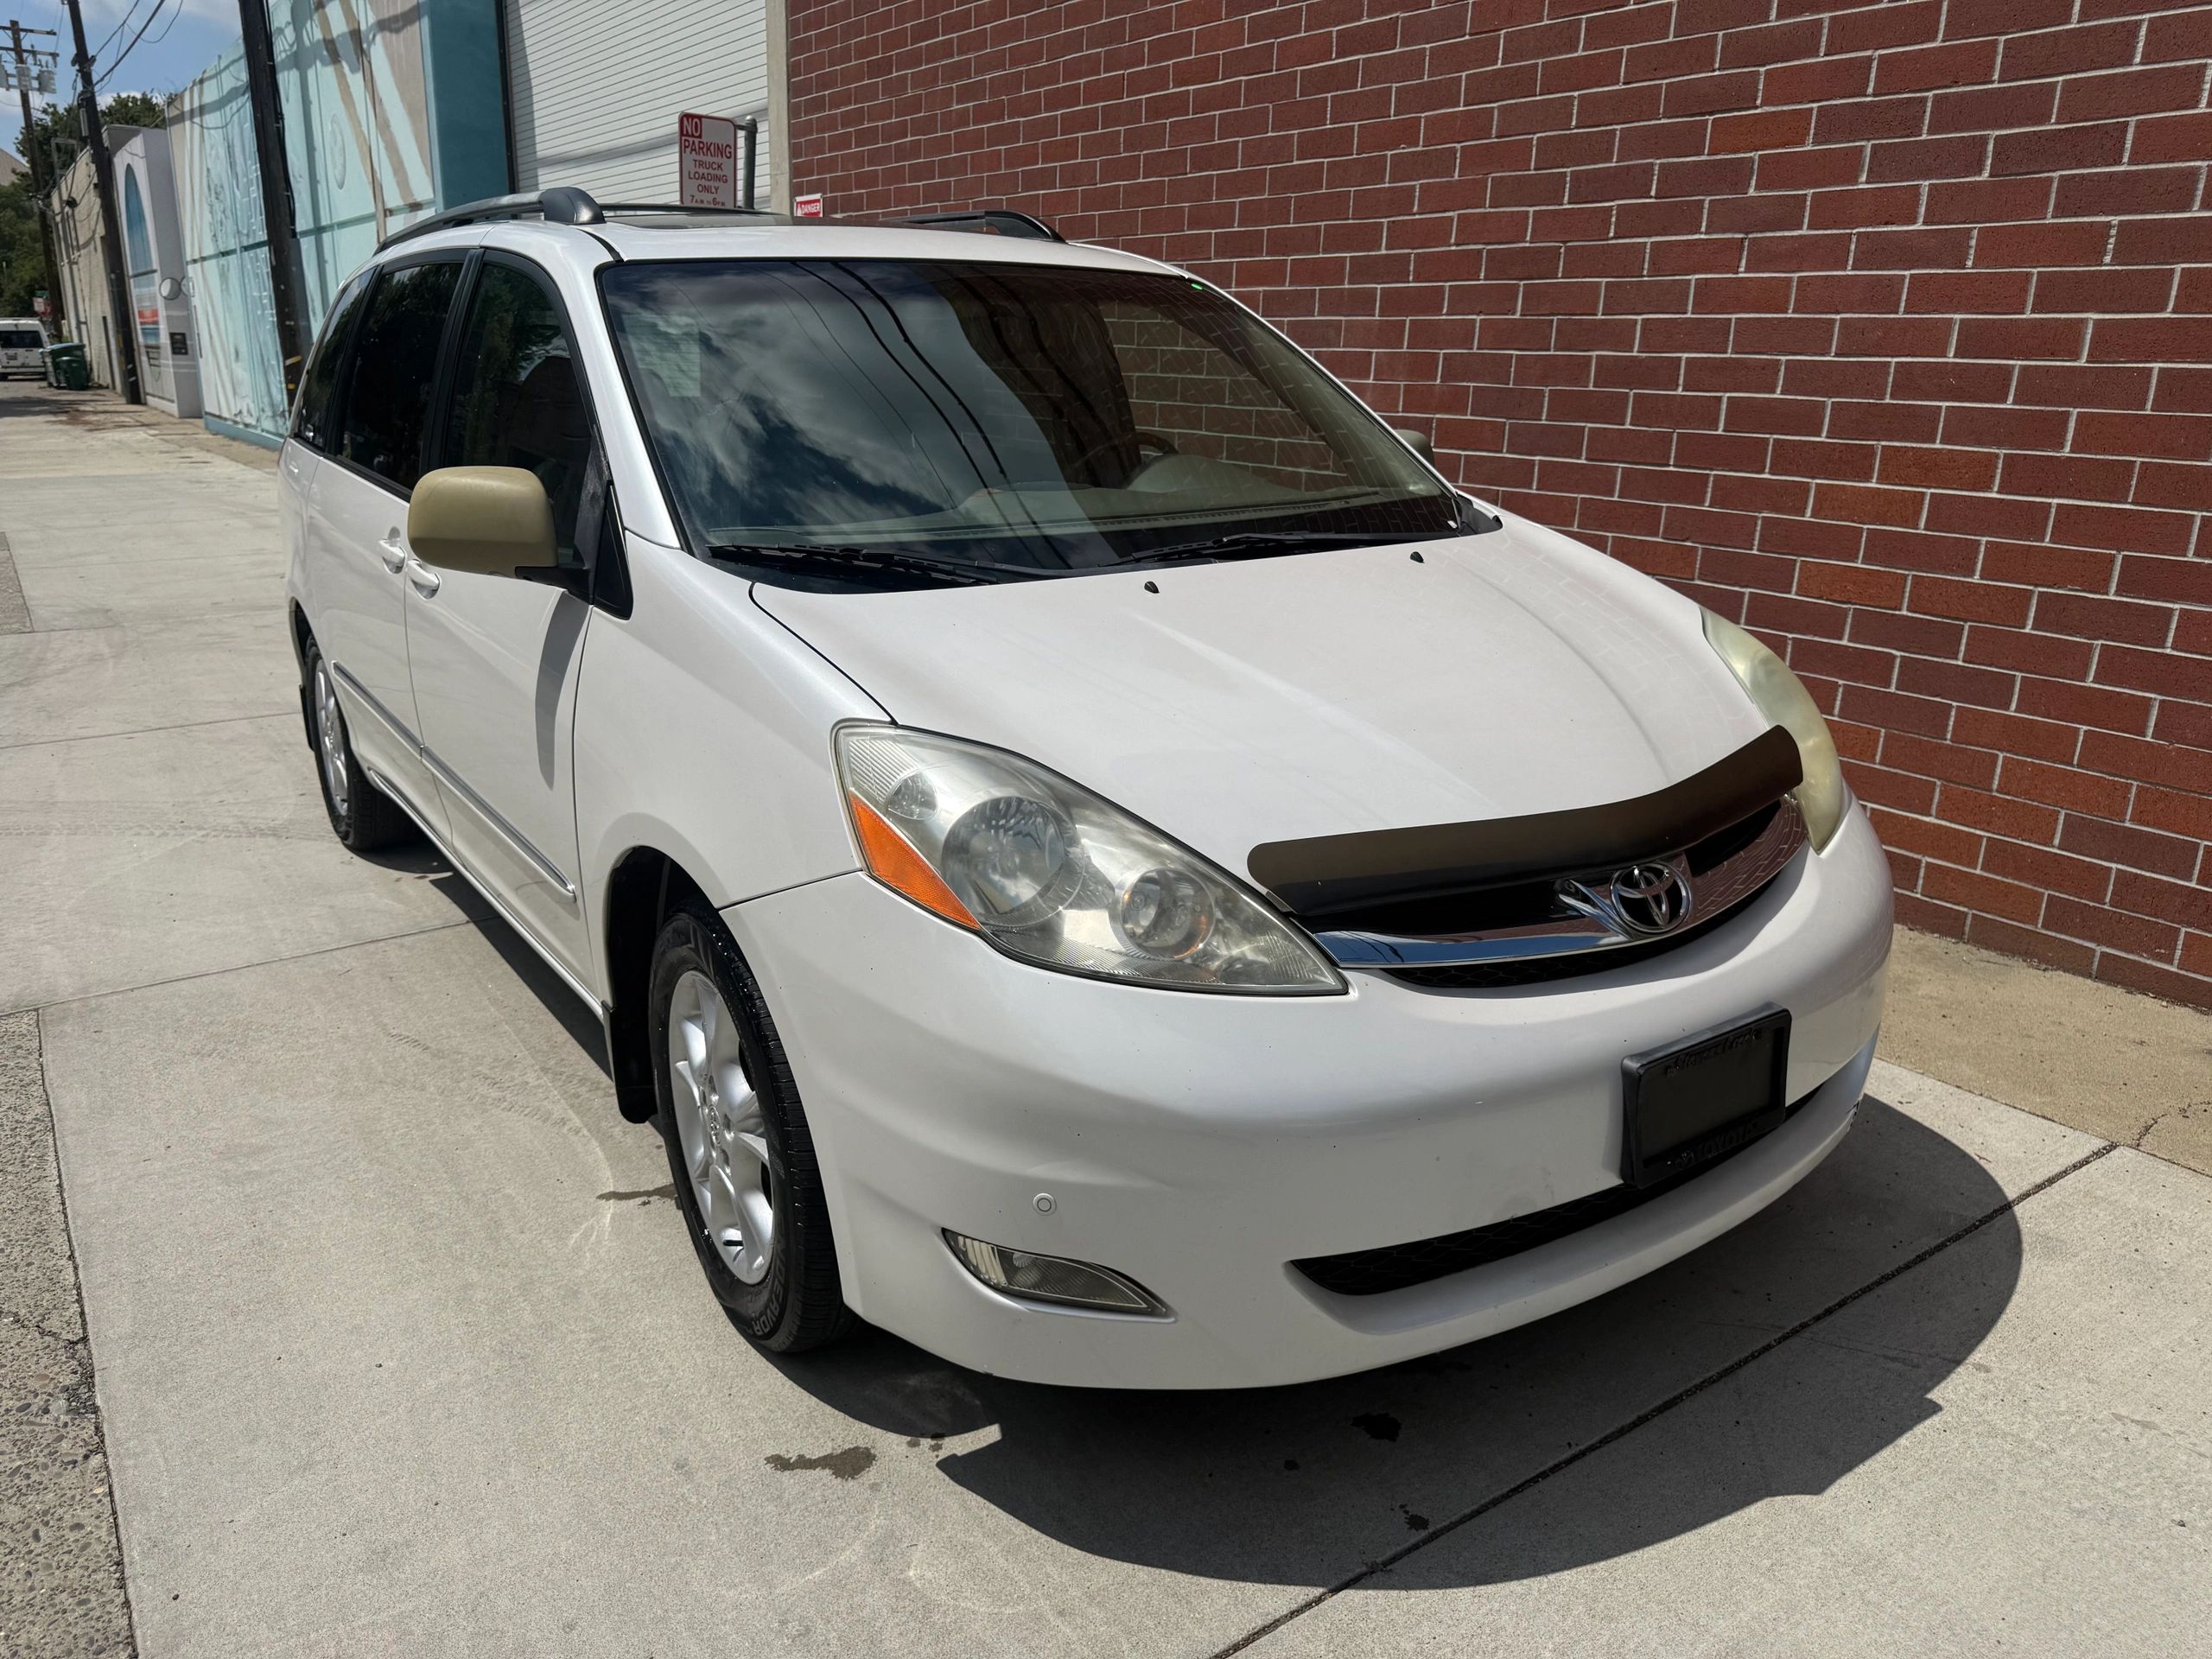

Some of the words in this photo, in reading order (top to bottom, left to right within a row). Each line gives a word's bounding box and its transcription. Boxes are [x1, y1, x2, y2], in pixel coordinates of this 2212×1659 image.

[683, 118, 701, 137] NO
[683, 139, 732, 159] PARKING
[693, 159, 723, 171] TRUCK
[688, 171, 728, 183] LOADING
[697, 183, 720, 194] ONLY
